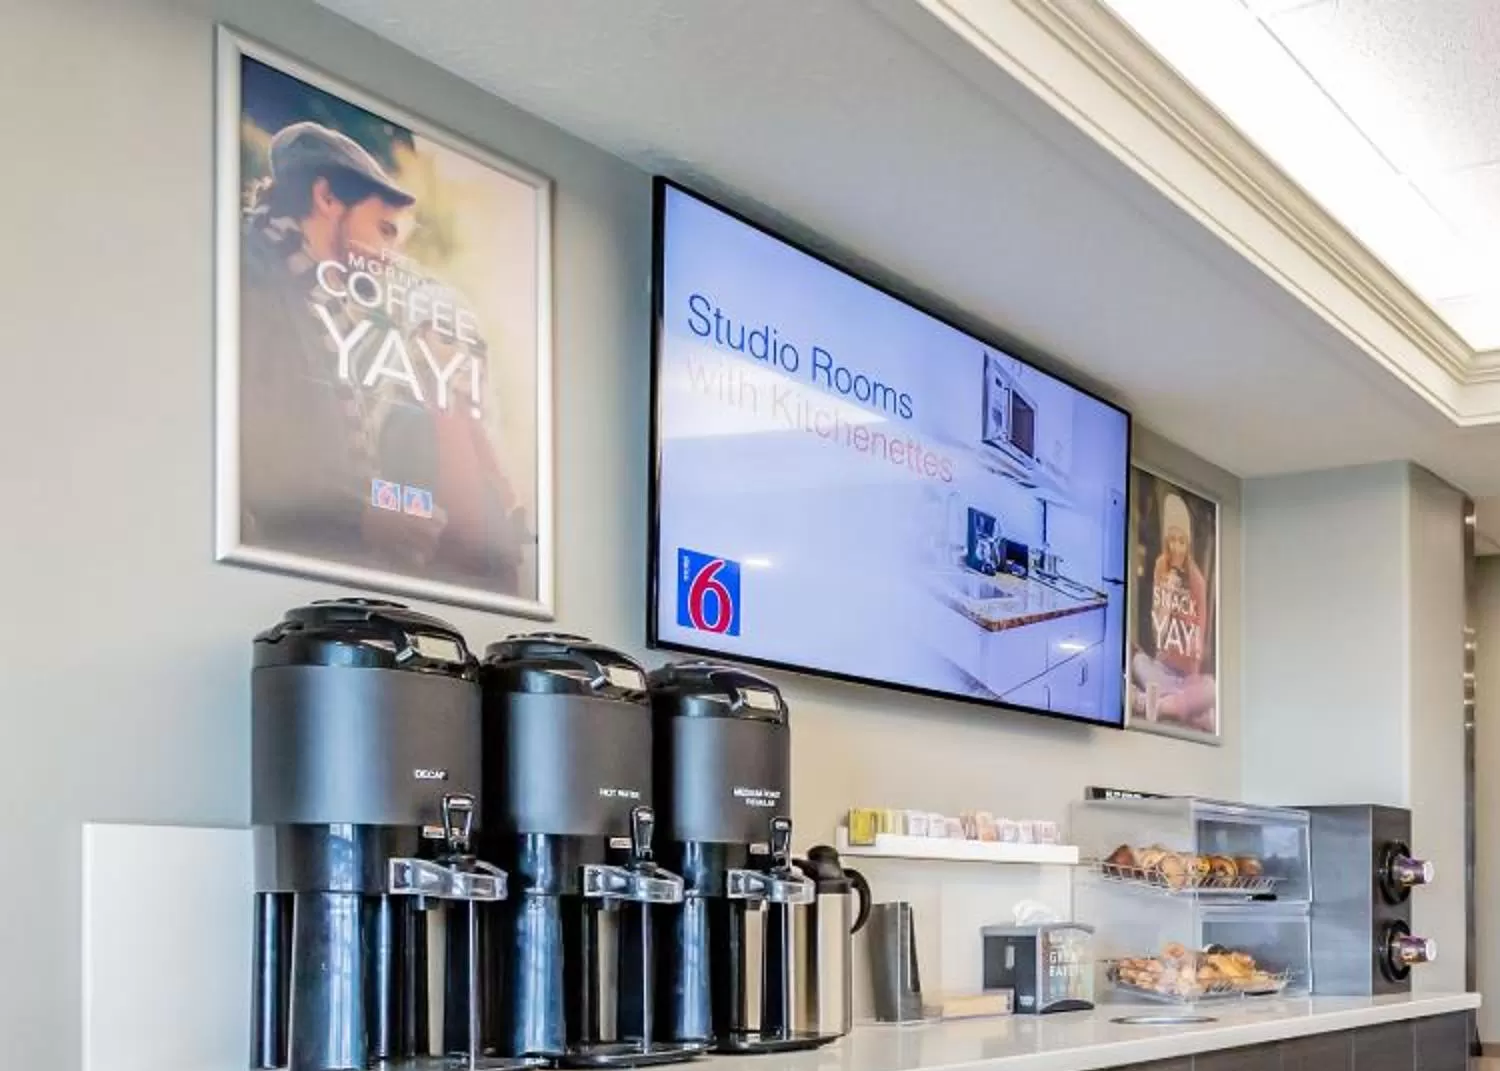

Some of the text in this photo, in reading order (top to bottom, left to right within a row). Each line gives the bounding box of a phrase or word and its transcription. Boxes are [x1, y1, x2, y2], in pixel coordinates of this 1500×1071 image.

[316, 259, 479, 345] COFFEE
[310, 303, 481, 419] YAY!
[687, 293, 914, 420] Studio Rooms
[687, 353, 953, 483] with Kitchenettes
[688, 559, 733, 634] 6
[1151, 610, 1201, 660] YAY!
